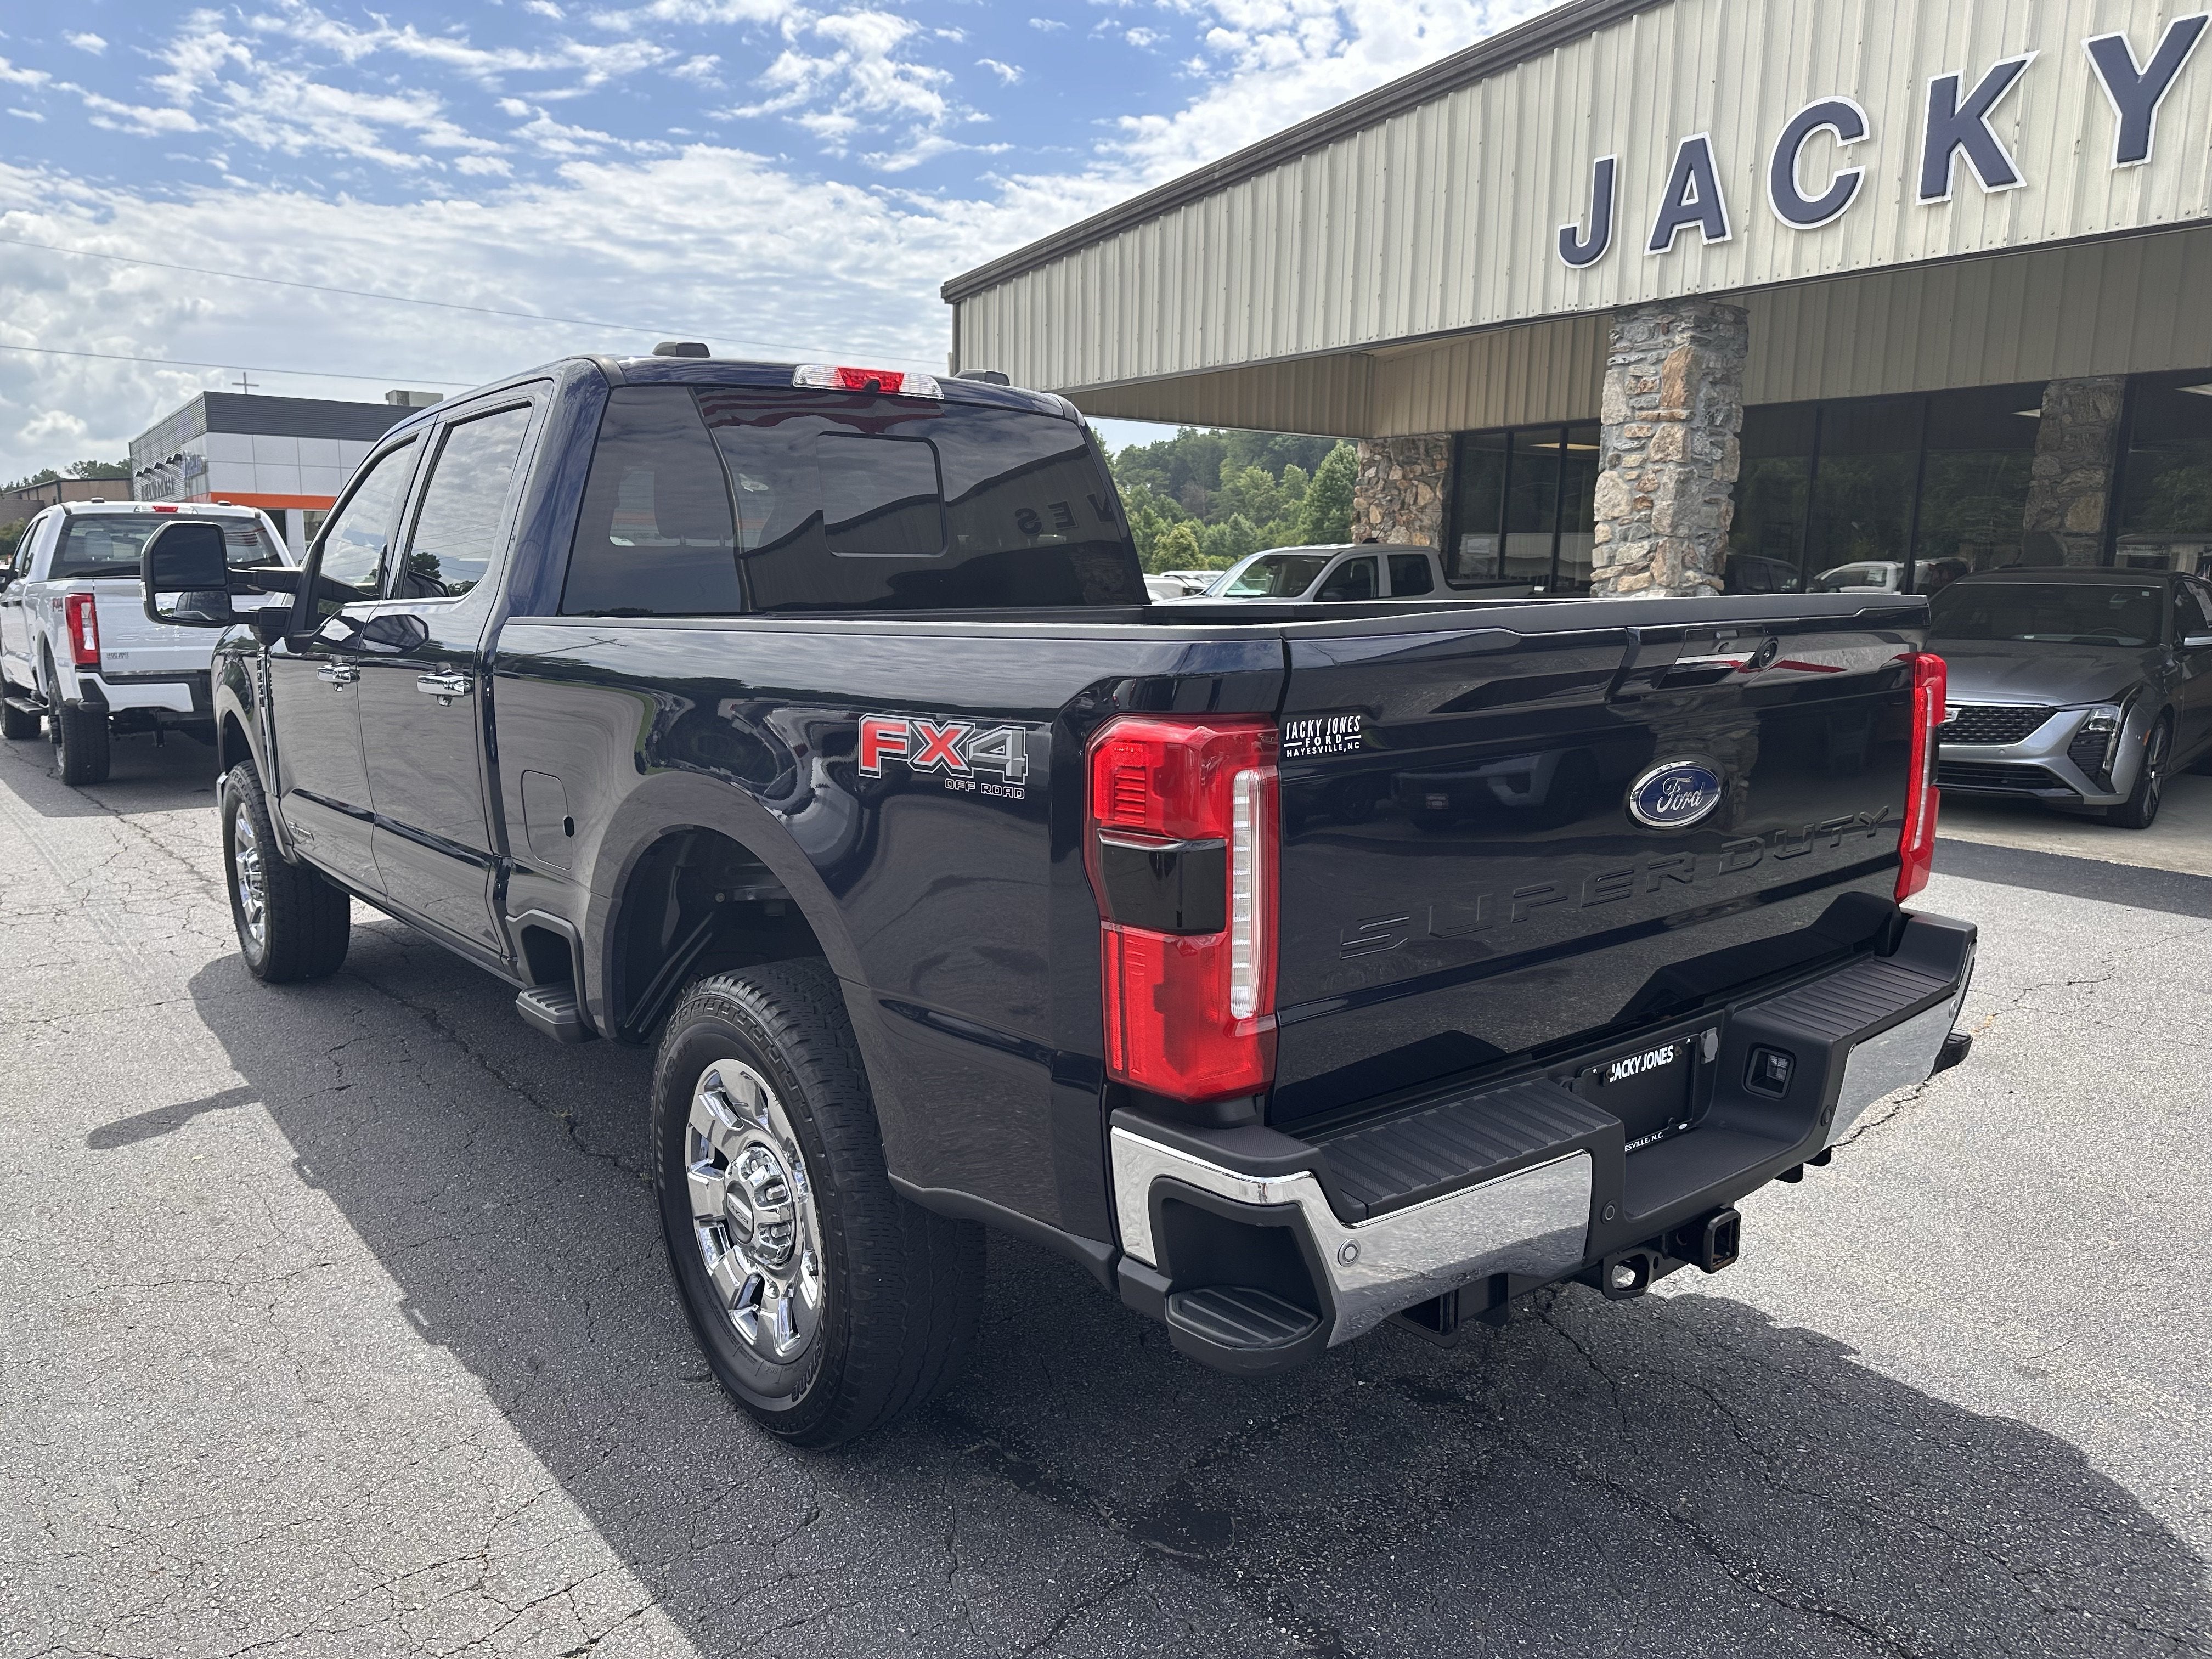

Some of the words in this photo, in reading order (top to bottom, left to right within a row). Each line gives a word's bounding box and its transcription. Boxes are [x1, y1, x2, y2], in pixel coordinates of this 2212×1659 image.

[1558, 11, 2210, 269] JACKY
[1285, 719, 1323, 740] JACKY
[1327, 715, 1361, 735] JONES
[1305, 733, 1342, 747] FORD
[859, 713, 1028, 785] FX4
[944, 778, 976, 792] OFF
[980, 782, 1025, 799] ROAD
[1656, 776, 1706, 814] Ford
[1339, 851, 1697, 960] SUPER
[1718, 805, 1890, 876] DUTY
[1609, 1055, 1643, 1082] JACKY
[1641, 1045, 1674, 1072] JONES
[1624, 1137, 1650, 1152] ESVILLE,
